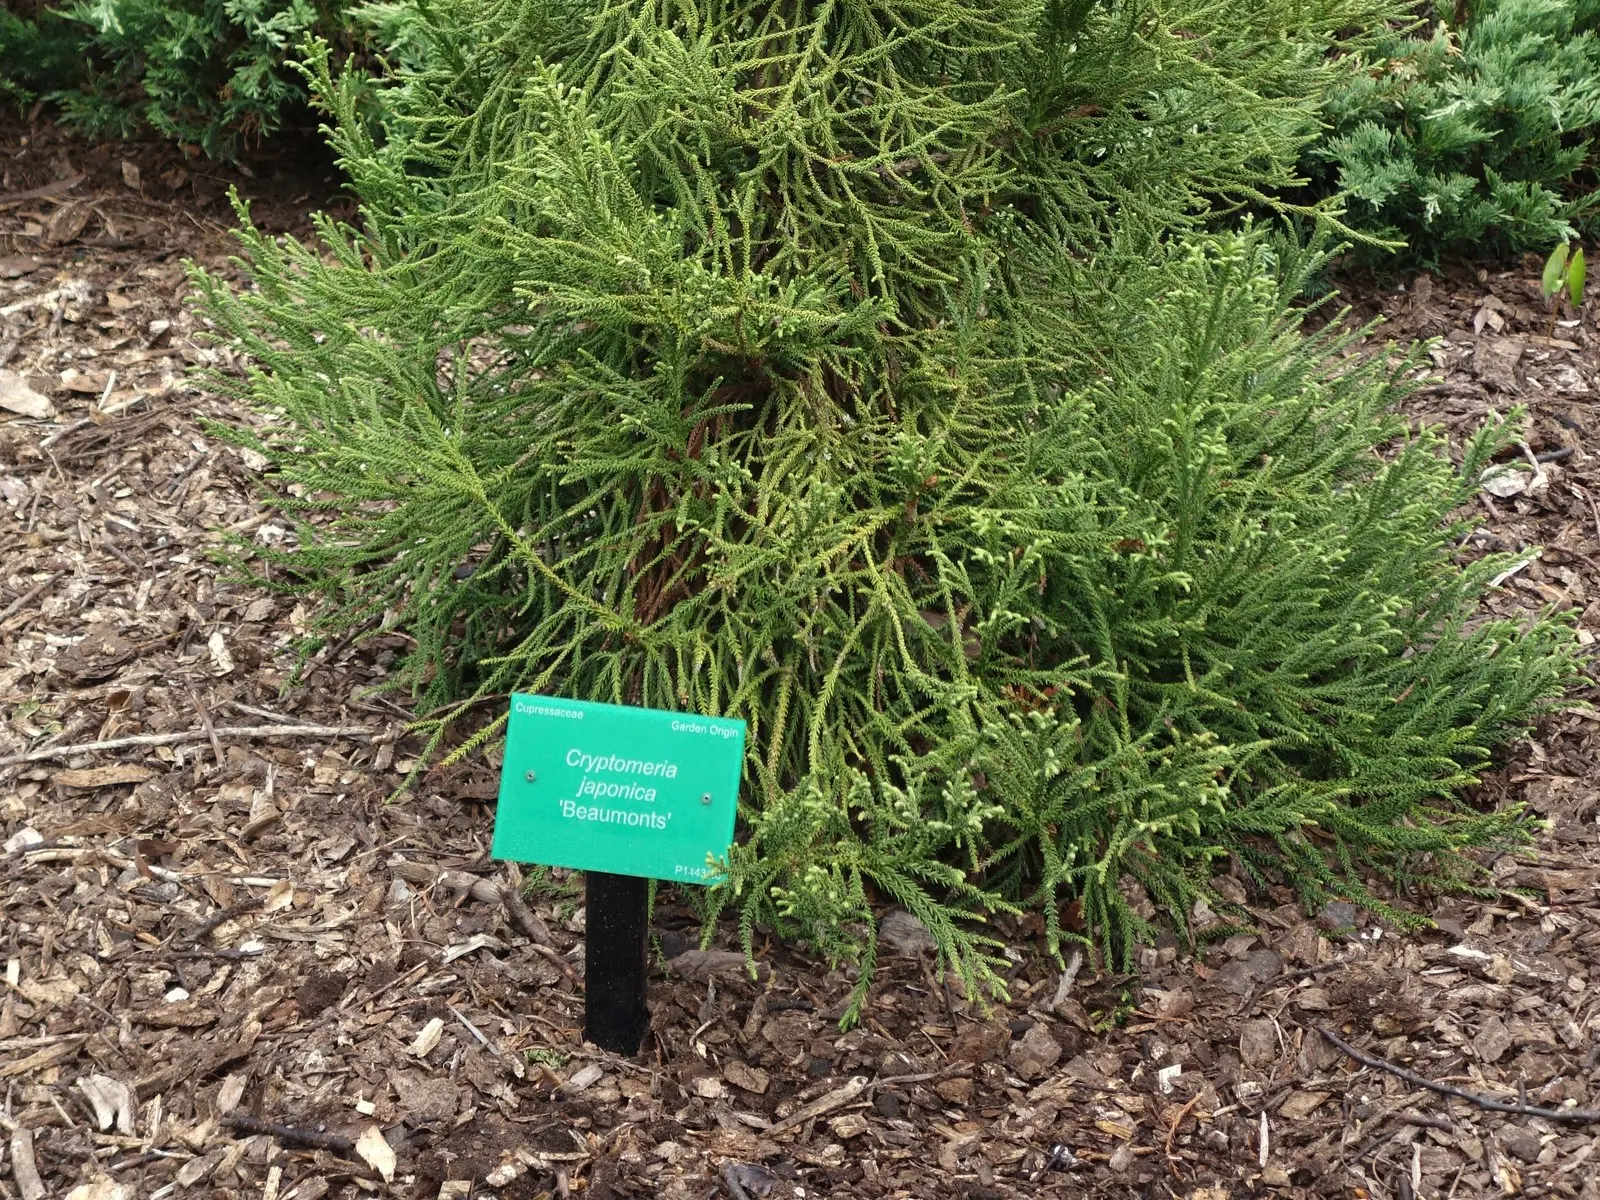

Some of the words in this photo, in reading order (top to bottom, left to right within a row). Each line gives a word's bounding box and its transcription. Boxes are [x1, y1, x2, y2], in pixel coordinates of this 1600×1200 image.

[515, 703, 584, 720] Cupressaceae
[671, 721, 707, 735] Garden
[709, 725, 739, 738] Origin
[566, 748, 678, 778] Cryptomeria
[576, 776, 656, 802] japonica
[559, 800, 671, 830] 'Beaumonts'
